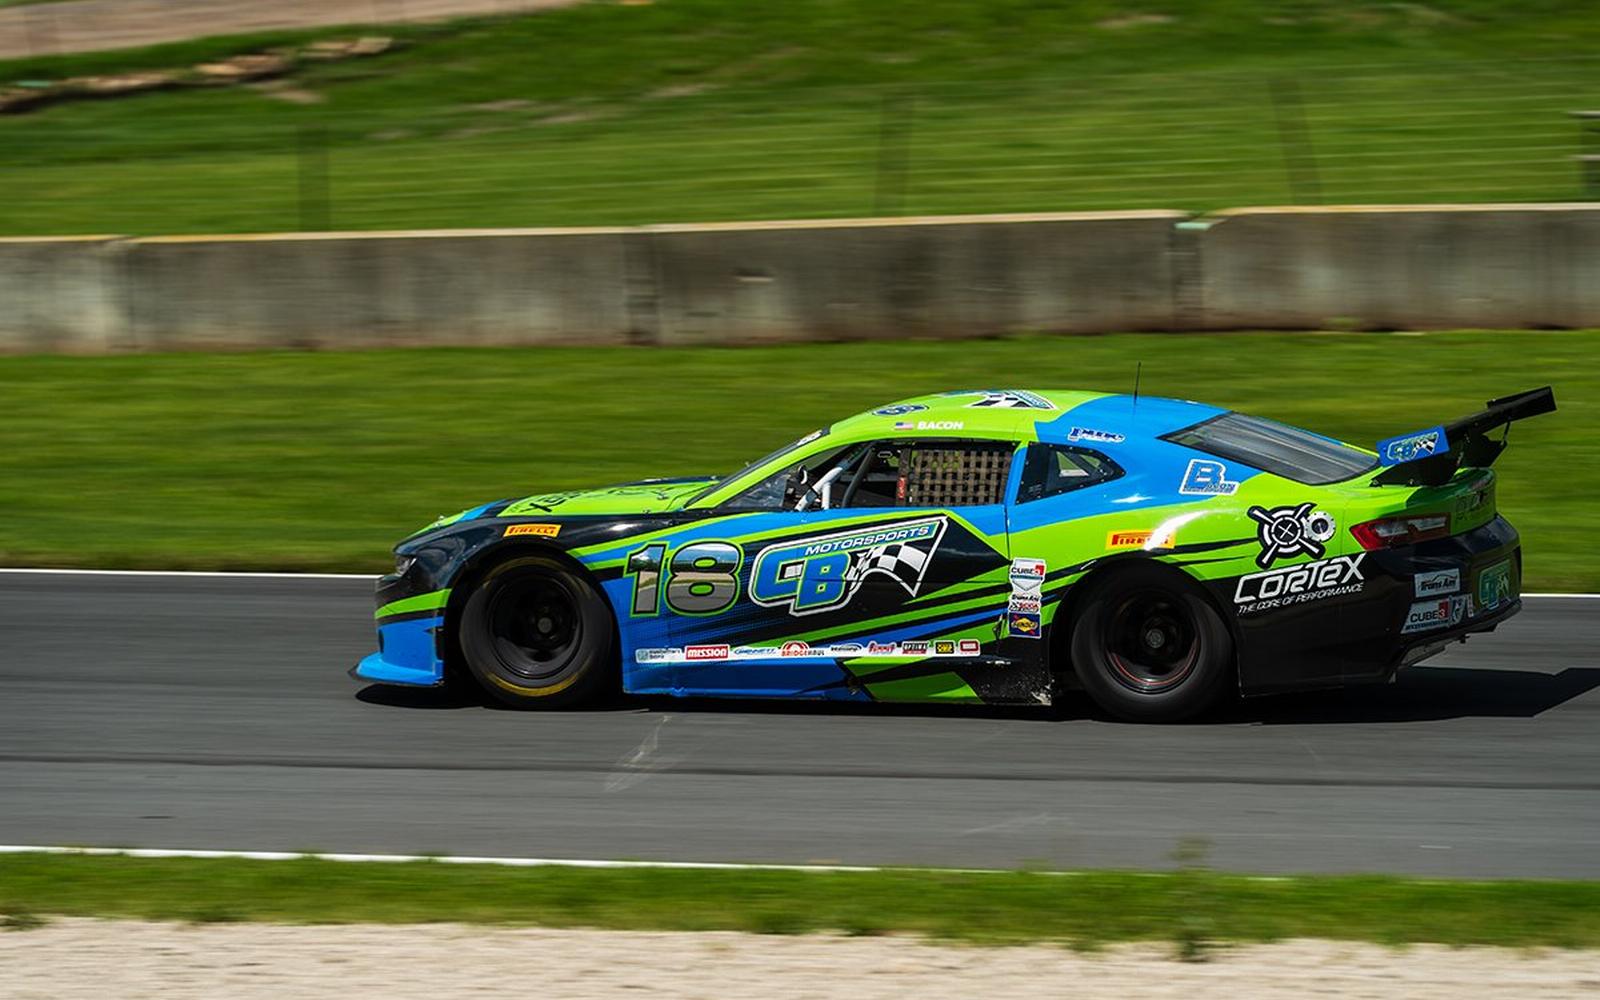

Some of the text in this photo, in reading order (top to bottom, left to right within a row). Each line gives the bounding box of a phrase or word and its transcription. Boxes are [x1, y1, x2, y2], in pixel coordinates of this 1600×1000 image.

[917, 420, 964, 430] BACON
[509, 526, 556, 535] PIRELLI
[804, 526, 930, 556] MOTORSPORTS
[625, 540, 744, 617] 18
[753, 548, 851, 611] CB
[1238, 582, 1365, 615] THE CORE OF PERFORMANCE
[1410, 606, 1447, 623] CUBE3
